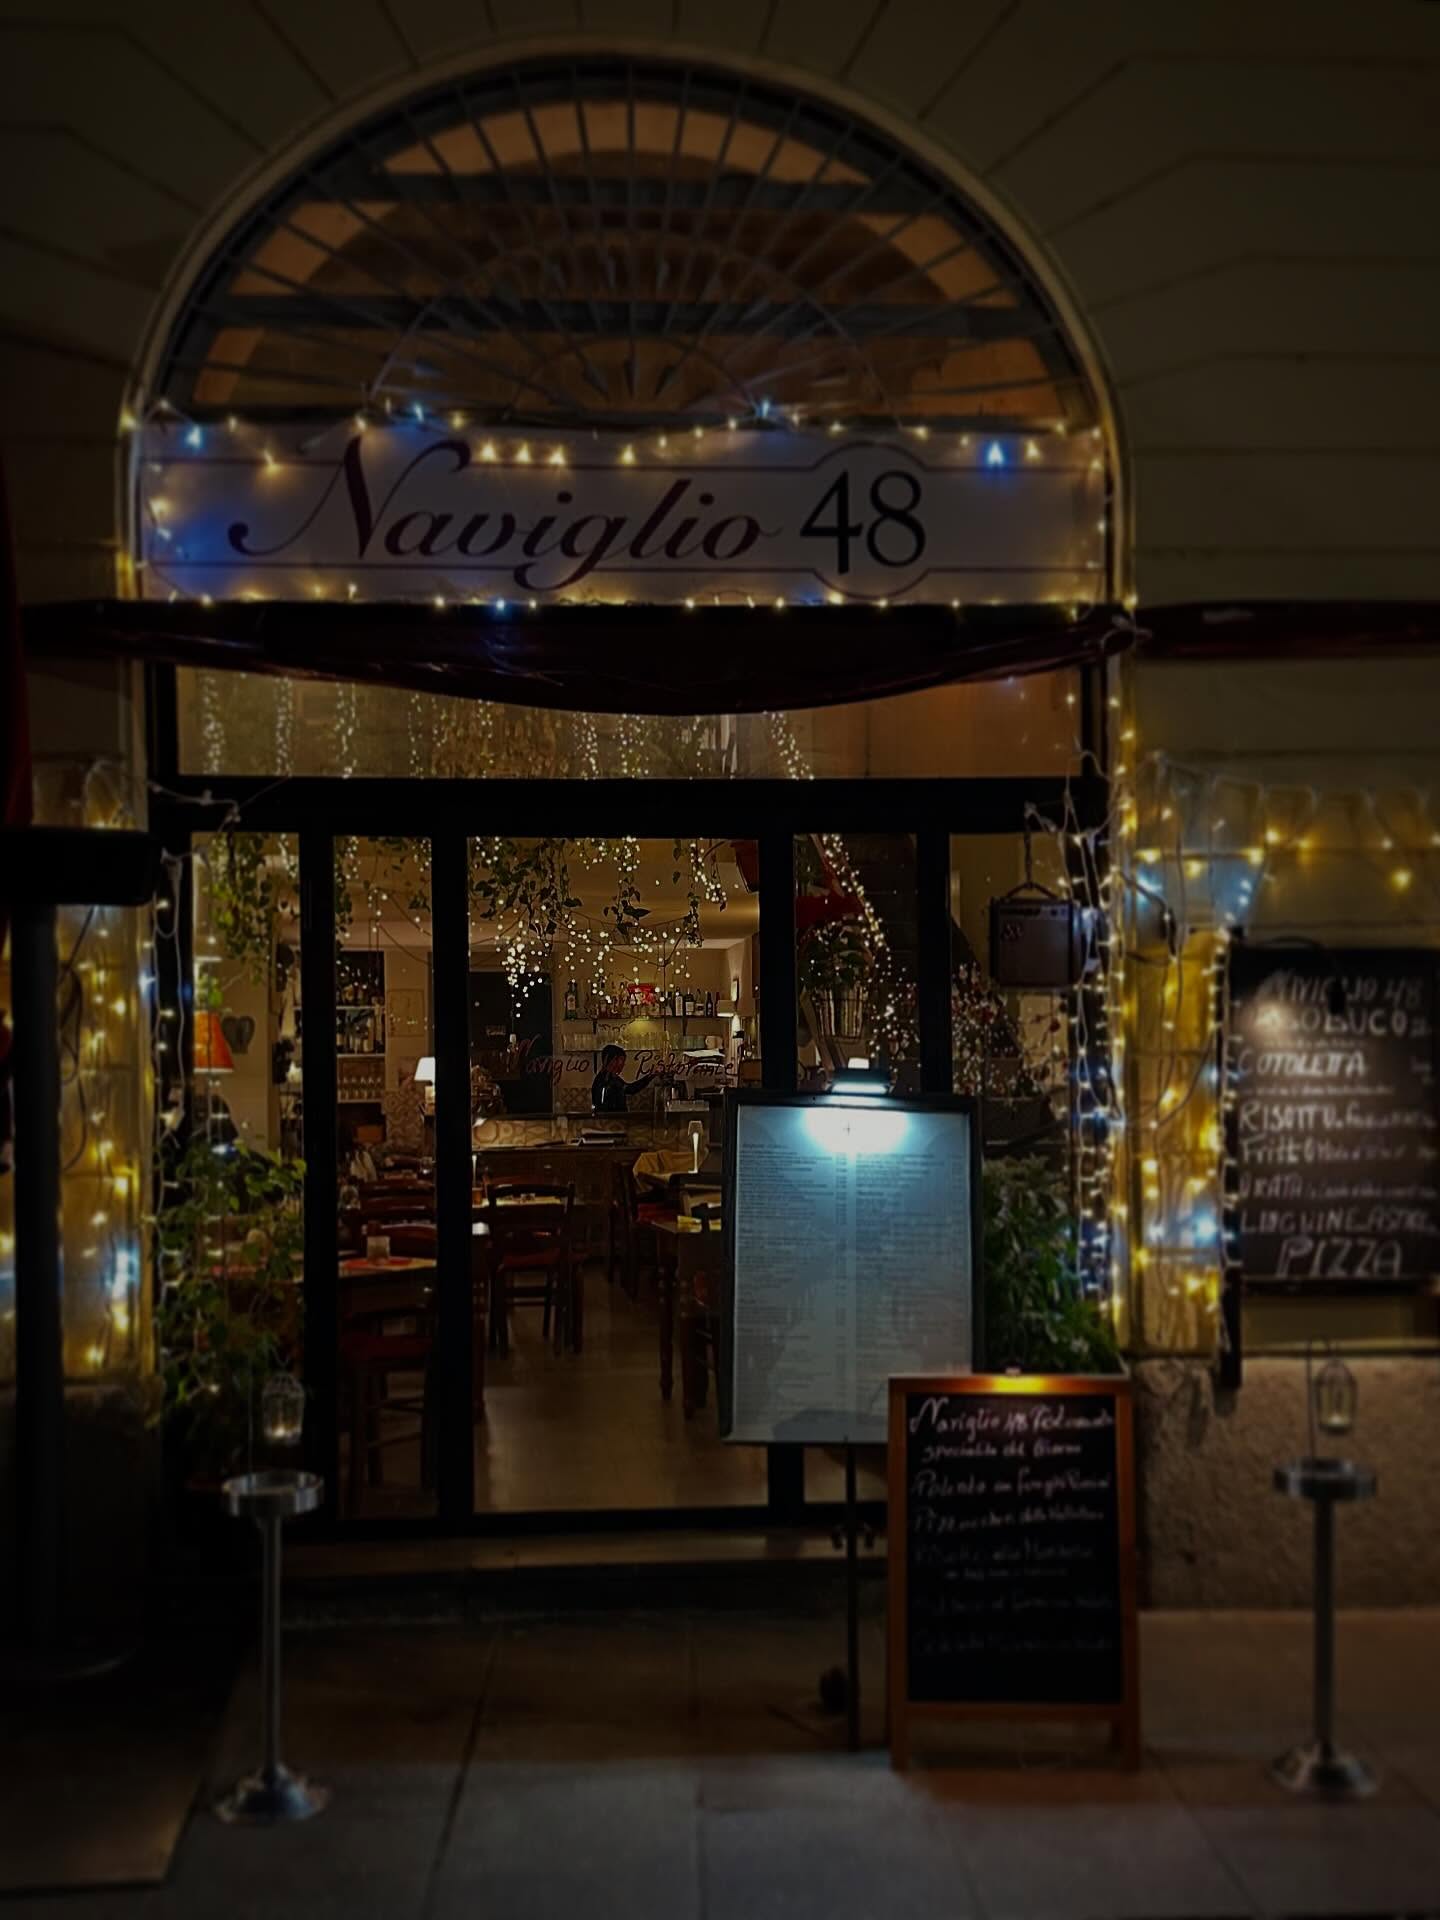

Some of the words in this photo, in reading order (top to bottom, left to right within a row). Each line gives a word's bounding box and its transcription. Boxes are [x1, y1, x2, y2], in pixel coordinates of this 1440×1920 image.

[228, 438, 782, 590] Naviglio
[800, 471, 926, 573] 48
[1275, 1235, 1404, 1279] PIZZA
[909, 1396, 1001, 1443] Naviglio
